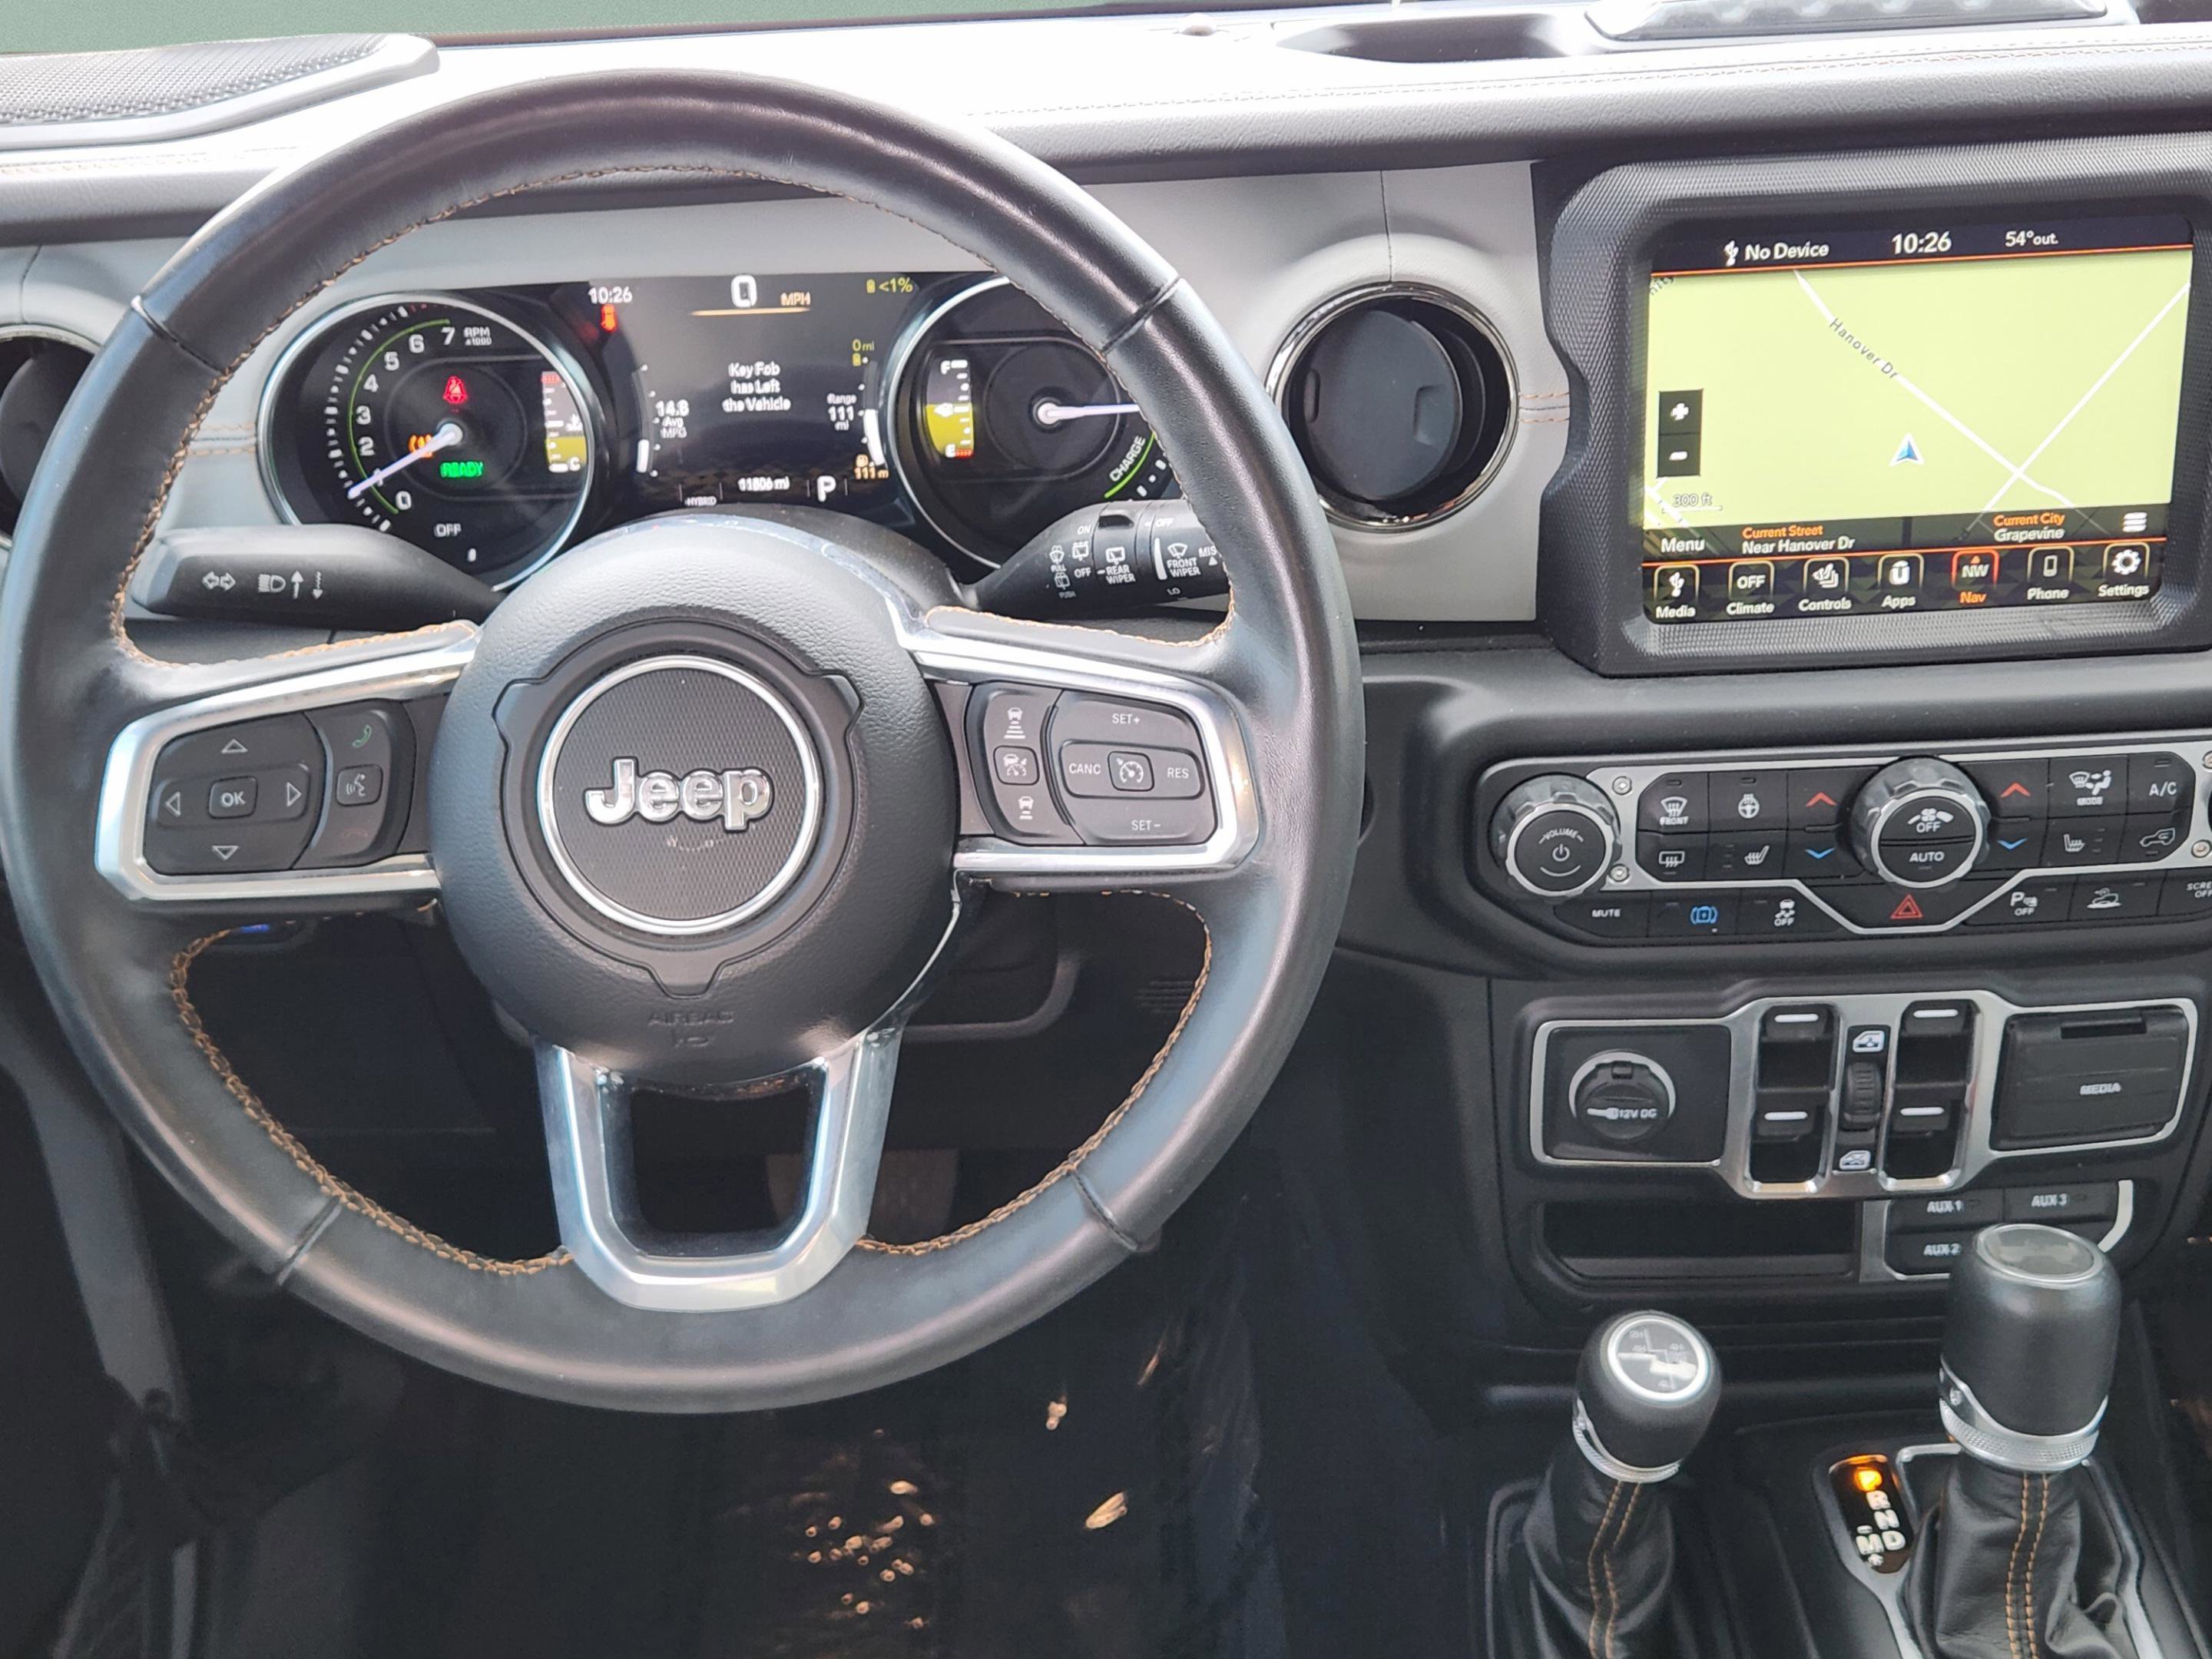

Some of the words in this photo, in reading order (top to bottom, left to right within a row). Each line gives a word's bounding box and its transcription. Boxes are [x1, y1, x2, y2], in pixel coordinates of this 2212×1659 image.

[1891, 232, 1952, 253] 10:26
[1744, 244, 1770, 261] No
[1773, 241, 1830, 259] Device
[731, 274, 757, 307] 0
[879, 277, 913, 293] <1%
[588, 286, 633, 303] 10:26
[780, 293, 811, 306] MPH
[442, 327, 455, 346] 7
[464, 326, 491, 337] RPM
[409, 334, 425, 353] 6
[853, 339, 861, 352] 0
[1829, 317, 1881, 365] Hanover
[1880, 359, 1899, 380] Dr
[385, 352, 399, 370] 5
[941, 359, 951, 375] F
[729, 363, 753, 379] Key
[755, 361, 780, 376] Fob
[364, 374, 379, 392] 4
[731, 379, 753, 394] has
[756, 378, 780, 393] Left
[722, 398, 745, 412] the
[746, 396, 791, 412] Vehicle
[826, 393, 857, 405] Range
[356, 406, 371, 424] 3
[655, 399, 690, 417] 14.8
[828, 406, 854, 422] 111
[662, 417, 684, 428] Avg
[661, 427, 687, 439] MPG
[359, 437, 375, 456] 2
[945, 442, 955, 458] E
[569, 458, 581, 472] C
[1109, 436, 1146, 483] CHARGE
[440, 462, 485, 478] READY
[854, 467, 876, 480] 111
[816, 475, 837, 502] P
[396, 490, 412, 510] 0
[1674, 494, 1697, 507] 300
[1700, 492, 1713, 505] ft
[1156, 518, 1174, 528] OFF
[1993, 515, 2038, 527] Current
[2040, 512, 2066, 526] City
[435, 524, 462, 536] OFF
[1077, 525, 1091, 535] ON
[1742, 526, 1786, 539] Current
[1789, 524, 1823, 538] Street
[1994, 527, 2066, 543] Grapevine
[1661, 537, 1705, 553] Menu
[1742, 541, 1775, 554] Near
[1777, 538, 1836, 553] Hanover
[1838, 535, 1855, 550] Dr
[1106, 564, 1131, 575] REAR
[1166, 557, 1197, 569] FRONT
[1074, 566, 1091, 578] OFF
[1106, 573, 1136, 584] WIPER
[1169, 567, 1201, 578] WIPER
[1962, 564, 1989, 578] NW
[1737, 575, 1766, 589] OFF
[1167, 587, 1181, 596] LO
[1960, 591, 1986, 604] Nav
[2027, 587, 2069, 601] Phone
[2098, 584, 2150, 598] Settings
[1726, 601, 1774, 615] Climate
[1799, 596, 1852, 611] Controls
[1881, 595, 1916, 610] Apps
[1655, 604, 1696, 619] Media
[1068, 763, 1101, 775] CANC
[1167, 767, 1190, 779] RES
[584, 757, 775, 832] Jeep
[2148, 782, 2177, 796] A/C
[220, 790, 244, 807] OK
[1660, 815, 1689, 826] FRONT
[1916, 821, 1941, 834] OFF
[1543, 828, 1579, 840] VOLUME
[1909, 851, 1945, 863] AUTO
[2010, 892, 2025, 907] P
[1591, 908, 1621, 918] MUTE
[2014, 908, 2035, 916] OFF
[1773, 917, 1795, 927] OFF
[2080, 1082, 2121, 1095] MEDIA
[1618, 1108, 1638, 1119] 12V
[1640, 1108, 1657, 1119] DC
[1927, 1200, 1952, 1214] AUX
[2032, 1194, 2056, 1207] AUX
[2058, 1193, 2068, 1206] 3
[1924, 1243, 1949, 1257] AUX
[1950, 1243, 1962, 1255] 2
[1866, 1490, 1891, 1510] R
[1874, 1509, 1900, 1530] N
[1856, 1534, 1884, 1555] M
[1882, 1530, 1906, 1551] D
